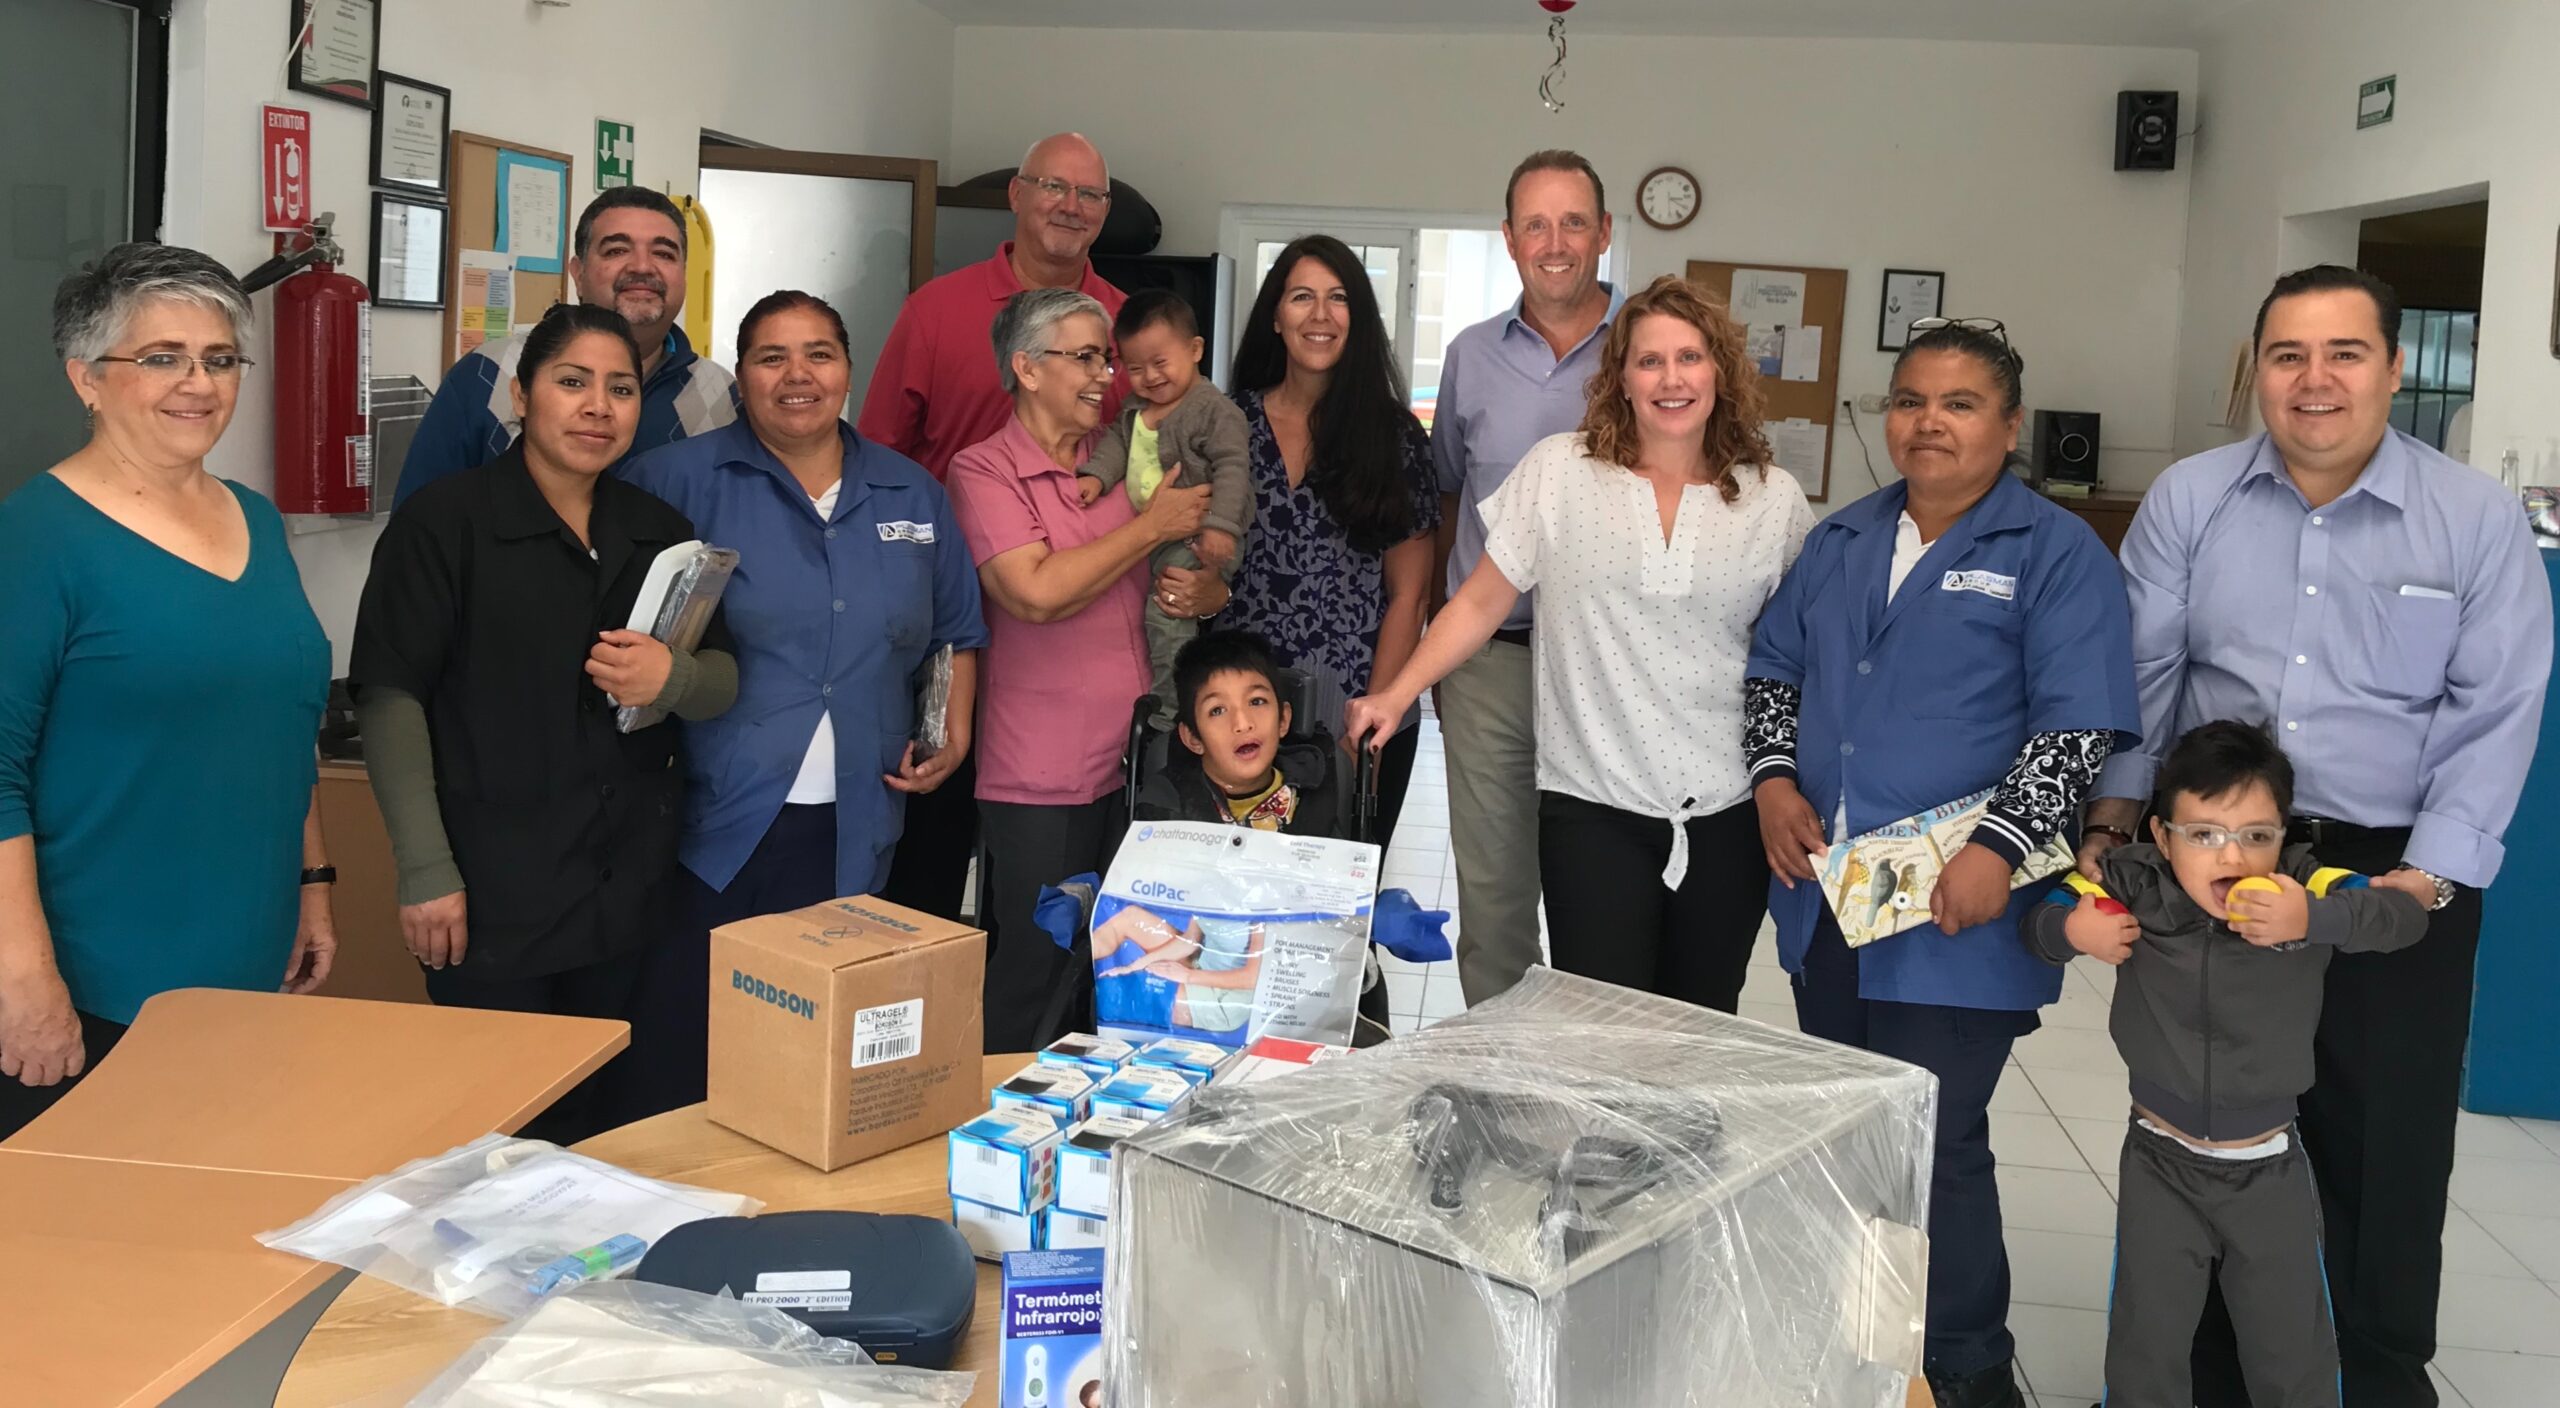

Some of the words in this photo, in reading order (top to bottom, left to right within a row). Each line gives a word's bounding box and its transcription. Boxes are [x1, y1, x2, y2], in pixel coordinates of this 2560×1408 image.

[268, 112, 305, 131] EXTINTOR
[1152, 828, 1221, 846] chattanooga
[1131, 880, 1185, 902] ColPac
[1288, 941, 1335, 954] MANAGEMENT
[732, 968, 814, 1021] BORDSON
[756, 1296, 773, 1304] PRO
[775, 1296, 800, 1304] 2000
[816, 1295, 850, 1304] EDITION
[1015, 1290, 1102, 1309] Termómet
[1015, 1307, 1096, 1326] Infrarrojo
